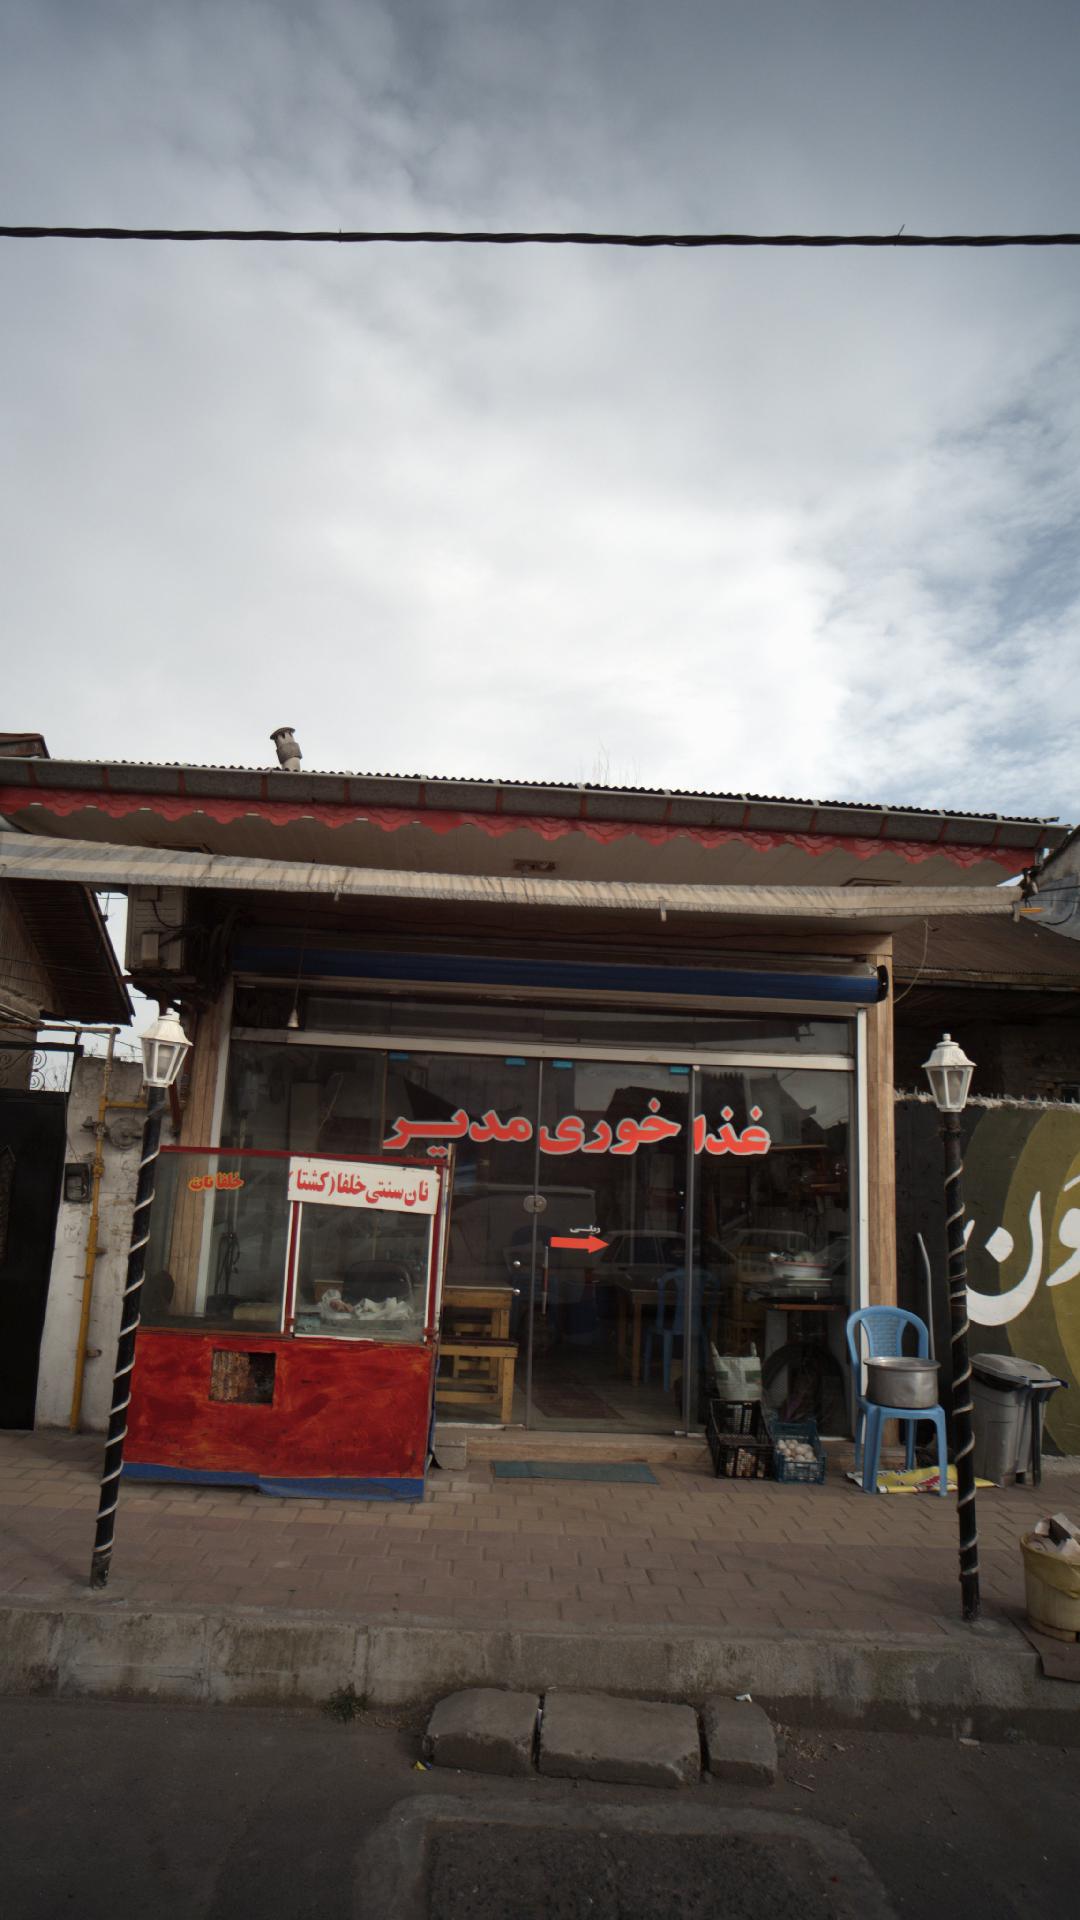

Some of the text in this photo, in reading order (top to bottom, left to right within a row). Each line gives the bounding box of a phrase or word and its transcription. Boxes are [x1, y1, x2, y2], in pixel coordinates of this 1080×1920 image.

[382, 1097, 771, 1157] غذا خوری مدیر
[336, 1172, 366, 1195] خلفا
[365, 1181, 404, 1204] سنتی
[404, 1180, 429, 1207] نان
